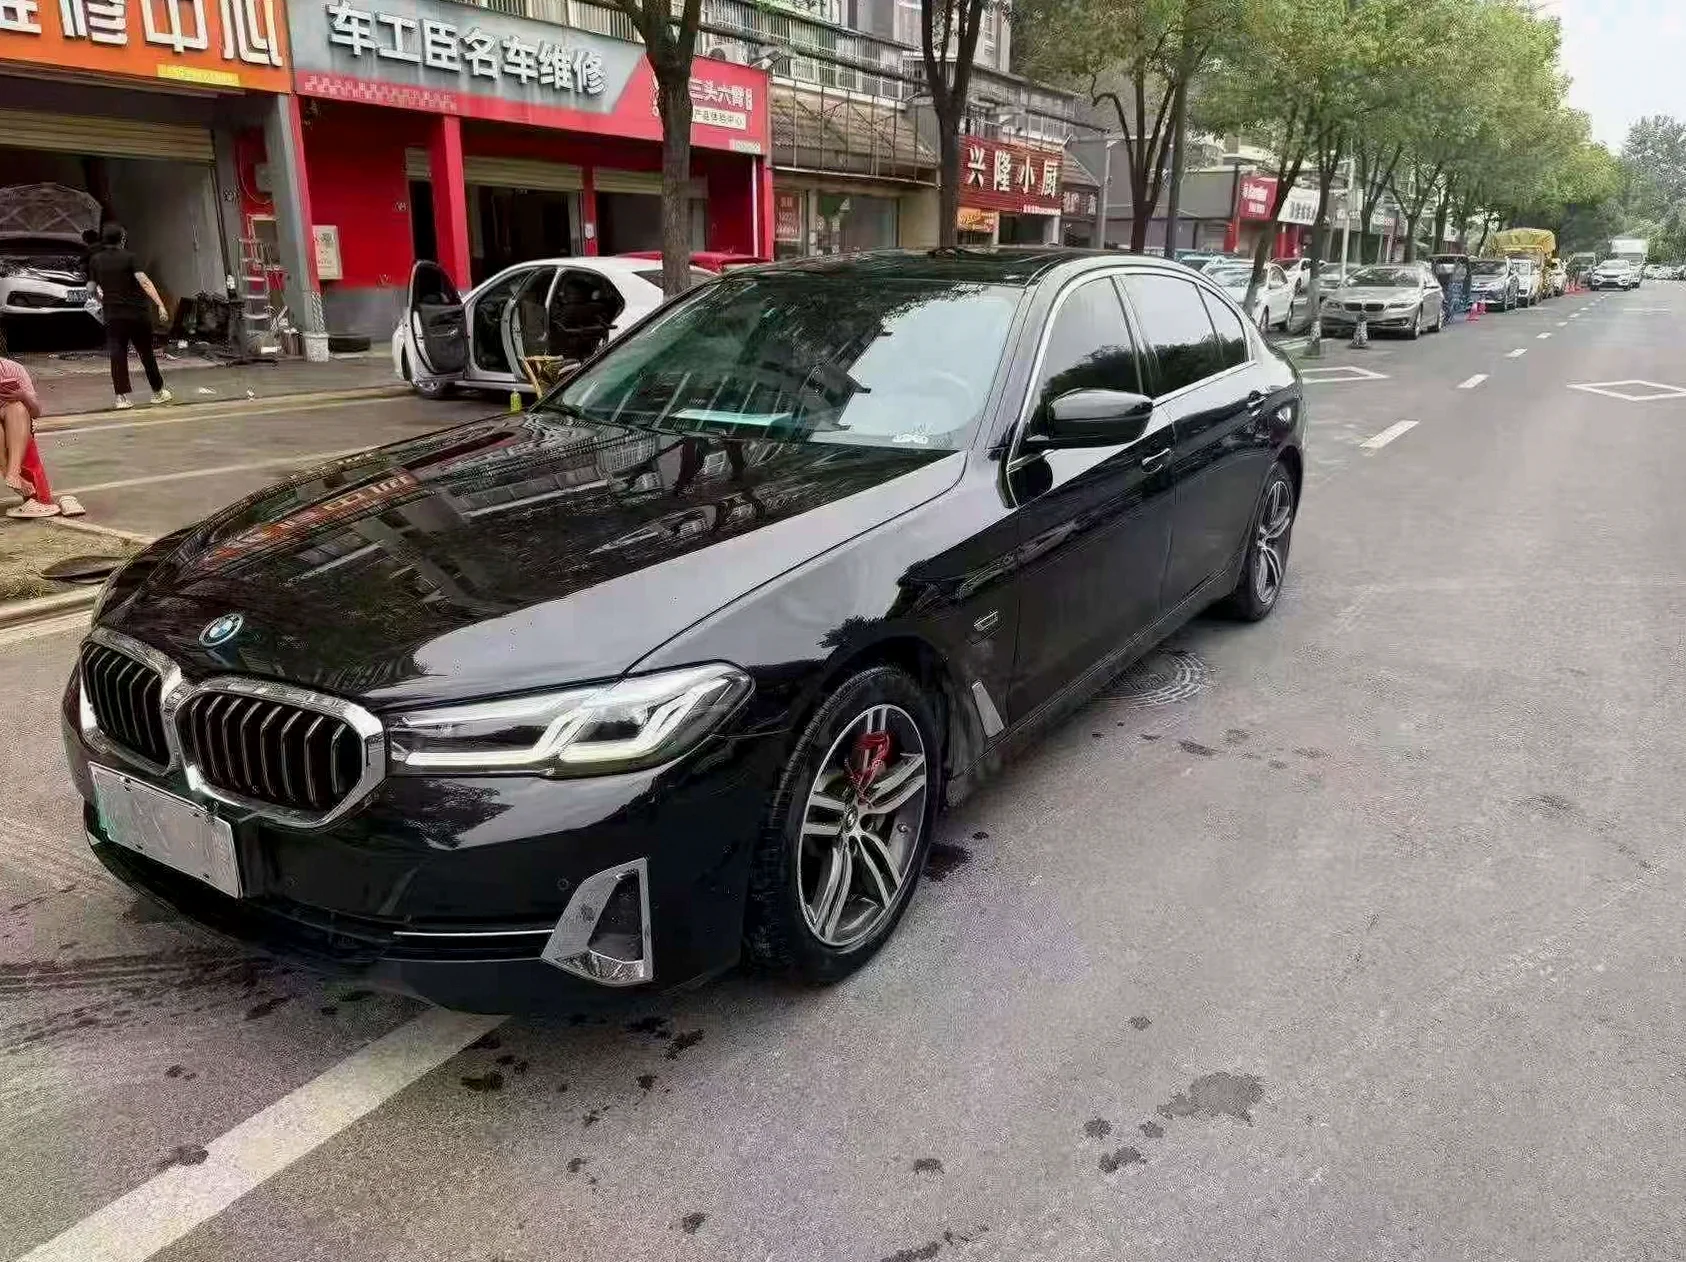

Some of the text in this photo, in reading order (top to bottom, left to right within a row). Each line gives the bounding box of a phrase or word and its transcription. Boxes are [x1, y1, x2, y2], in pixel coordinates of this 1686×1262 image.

[325, 0, 607, 95] 车工臣名车维修
[967, 145, 1059, 198] 兴隆小厨
